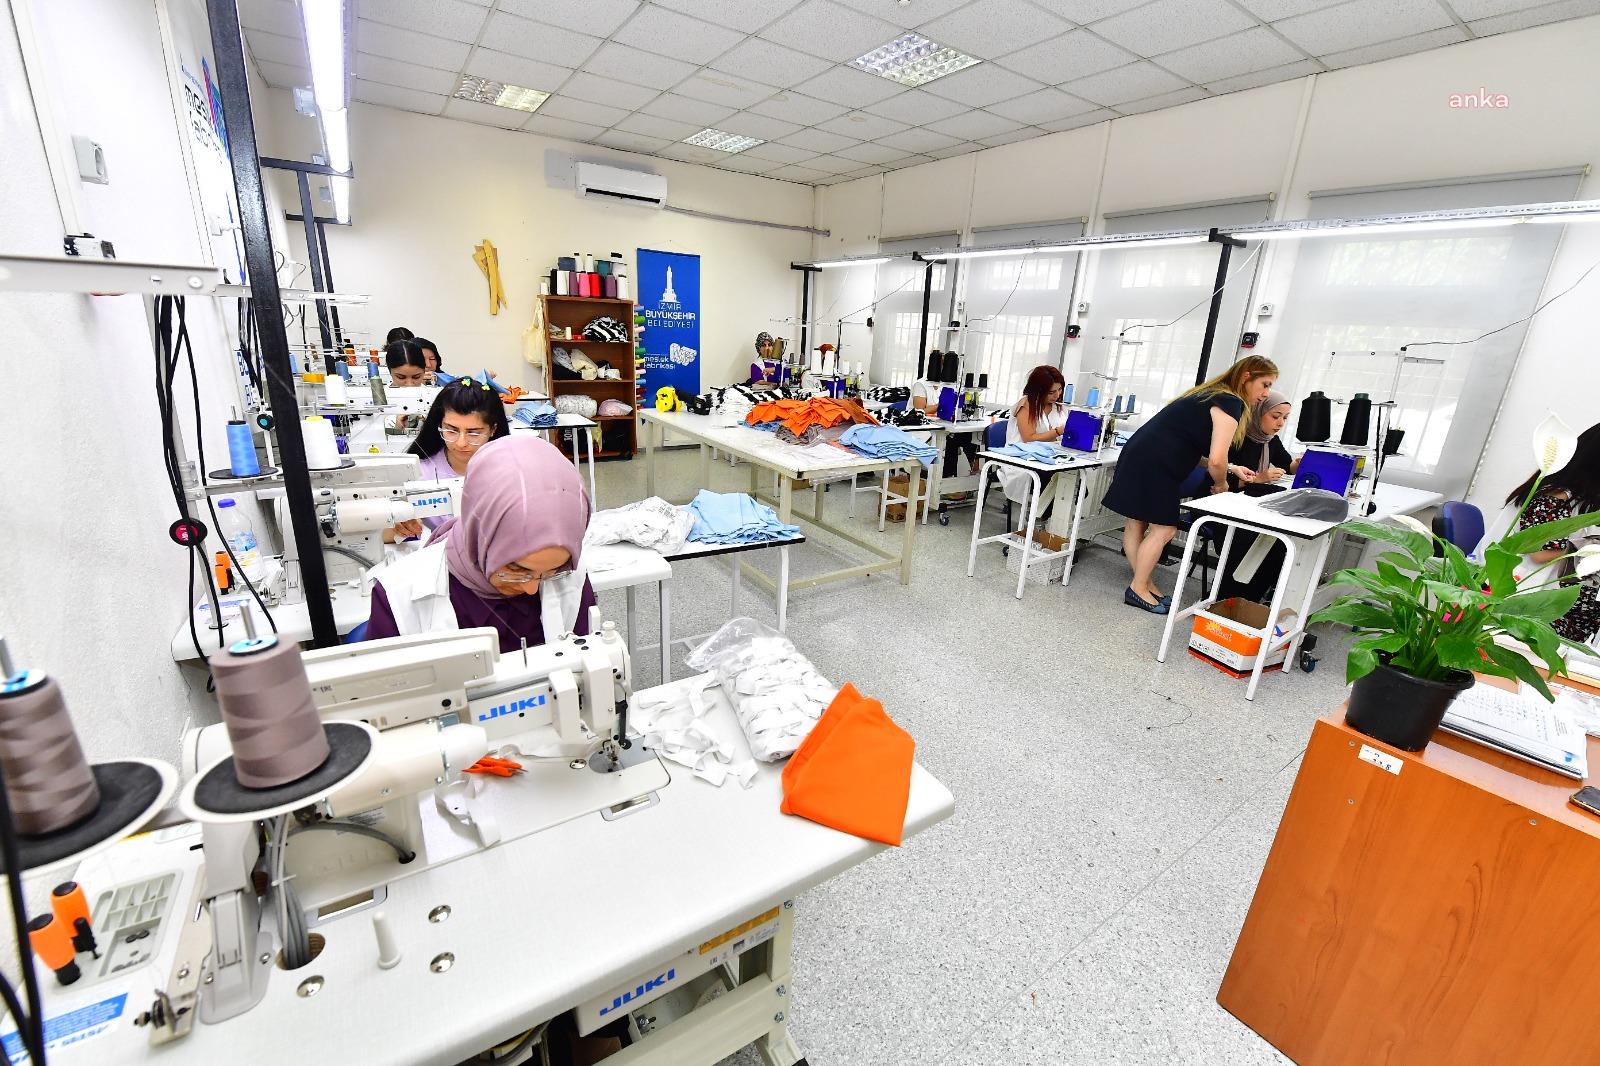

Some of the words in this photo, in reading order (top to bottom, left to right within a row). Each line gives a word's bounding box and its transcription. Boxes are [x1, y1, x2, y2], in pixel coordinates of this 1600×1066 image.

[645, 309, 696, 320] BÜYÜKŞEHİR
[411, 496, 448, 507] JUKI
[478, 694, 546, 722] JUKI
[599, 968, 675, 1017] JUKI
